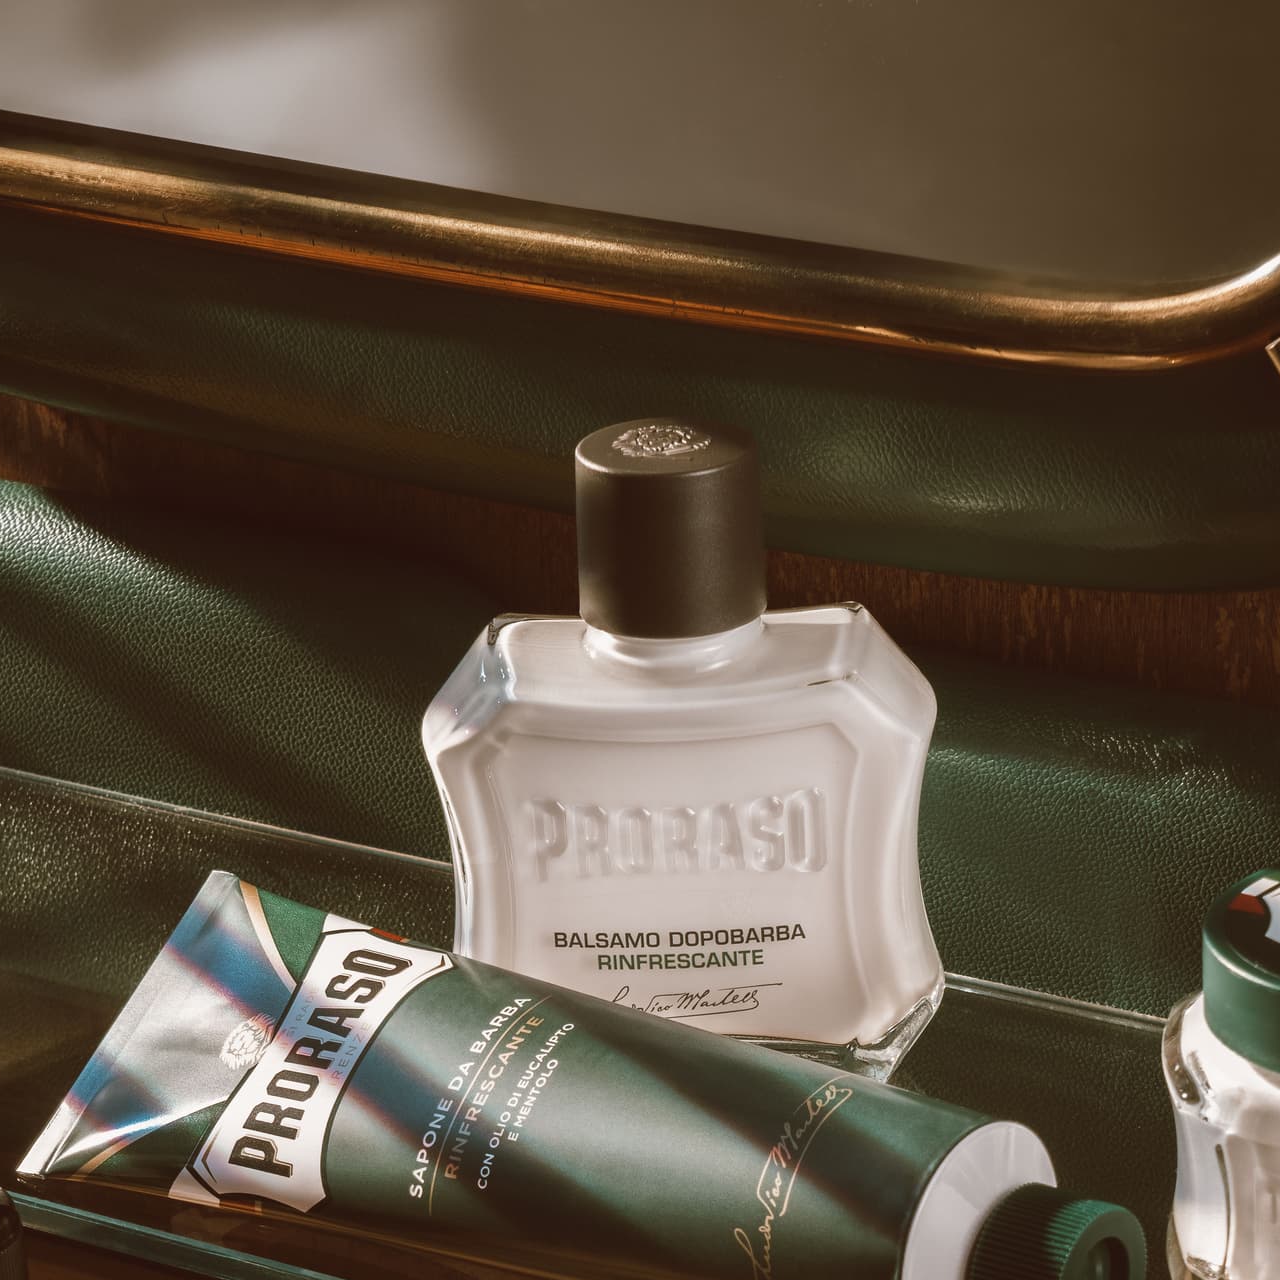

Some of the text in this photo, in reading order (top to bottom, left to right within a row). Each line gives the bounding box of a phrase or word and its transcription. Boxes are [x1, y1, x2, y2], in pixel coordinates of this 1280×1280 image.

[528, 786, 829, 881] PRORASO
[553, 923, 807, 949] BALSAMO DOPOBARBA
[597, 949, 765, 970] RINFRESCANTE
[228, 948, 413, 1178] PRORASO
[409, 997, 532, 1199] SAPONE DA BARBA
[443, 1015, 545, 1180] RINFRESCANTE
[477, 1022, 576, 1190] CON OLIO DI EUCALIPTO
[507, 1058, 560, 1142] E MENTOLO
